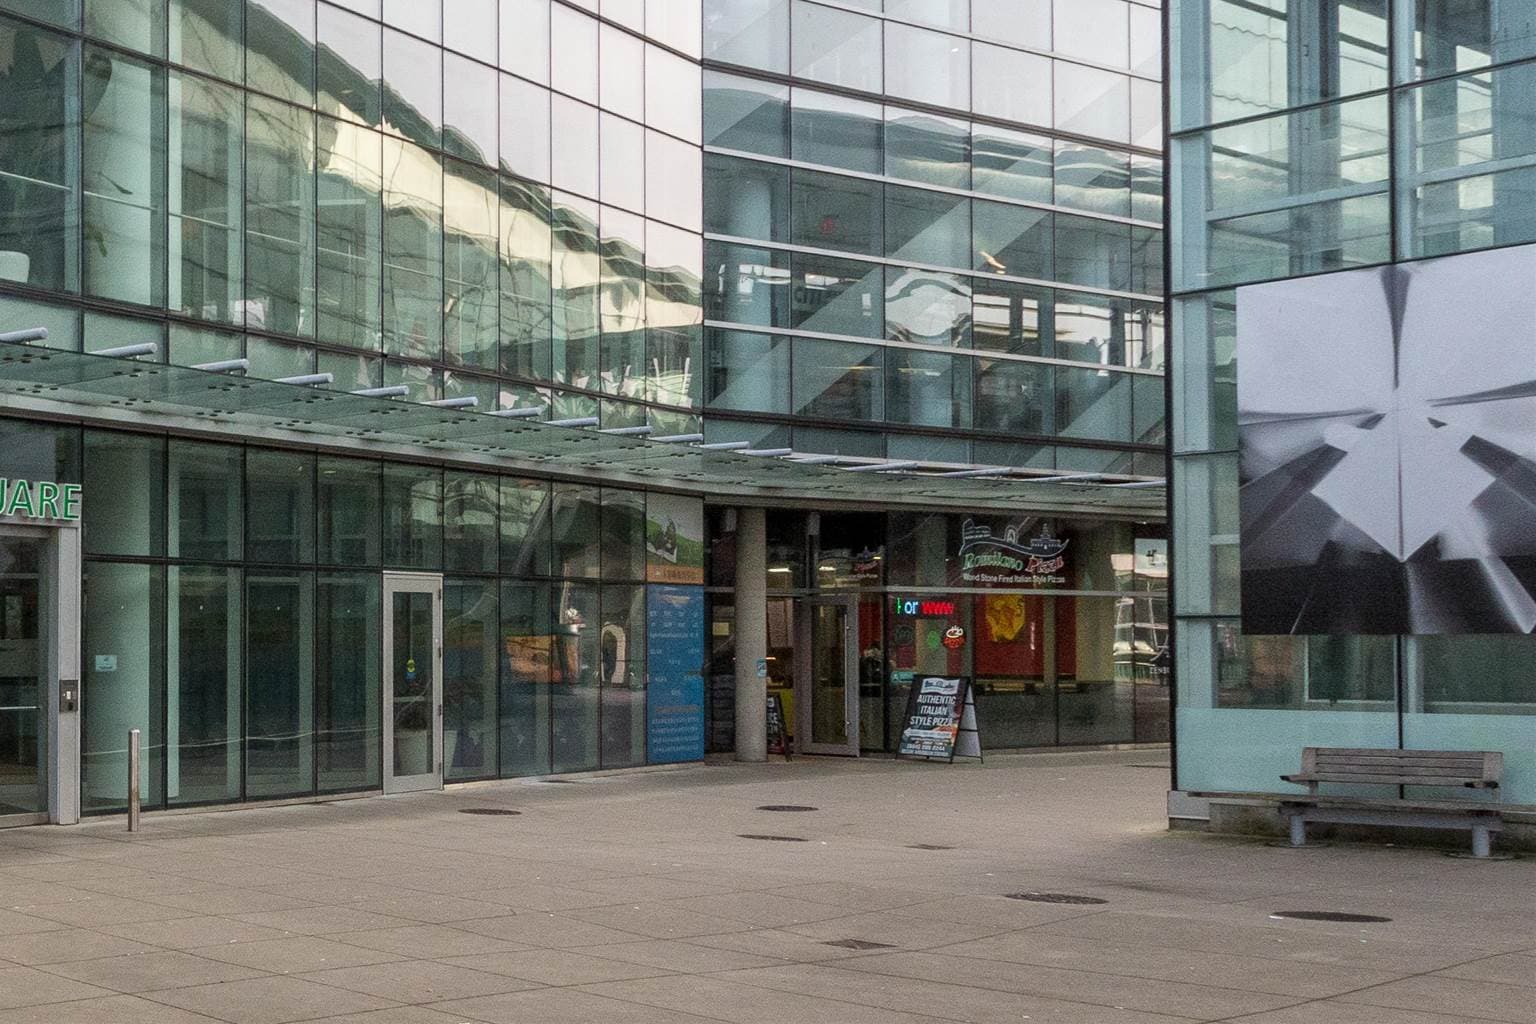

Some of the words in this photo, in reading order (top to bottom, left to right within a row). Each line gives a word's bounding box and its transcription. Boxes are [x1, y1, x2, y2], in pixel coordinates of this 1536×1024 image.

[916, 694, 957, 704] AUTHENTIC
[920, 705, 948, 715] ITALIAN
[910, 716, 931, 726] STYLE
[932, 716, 953, 726] PIZZA
